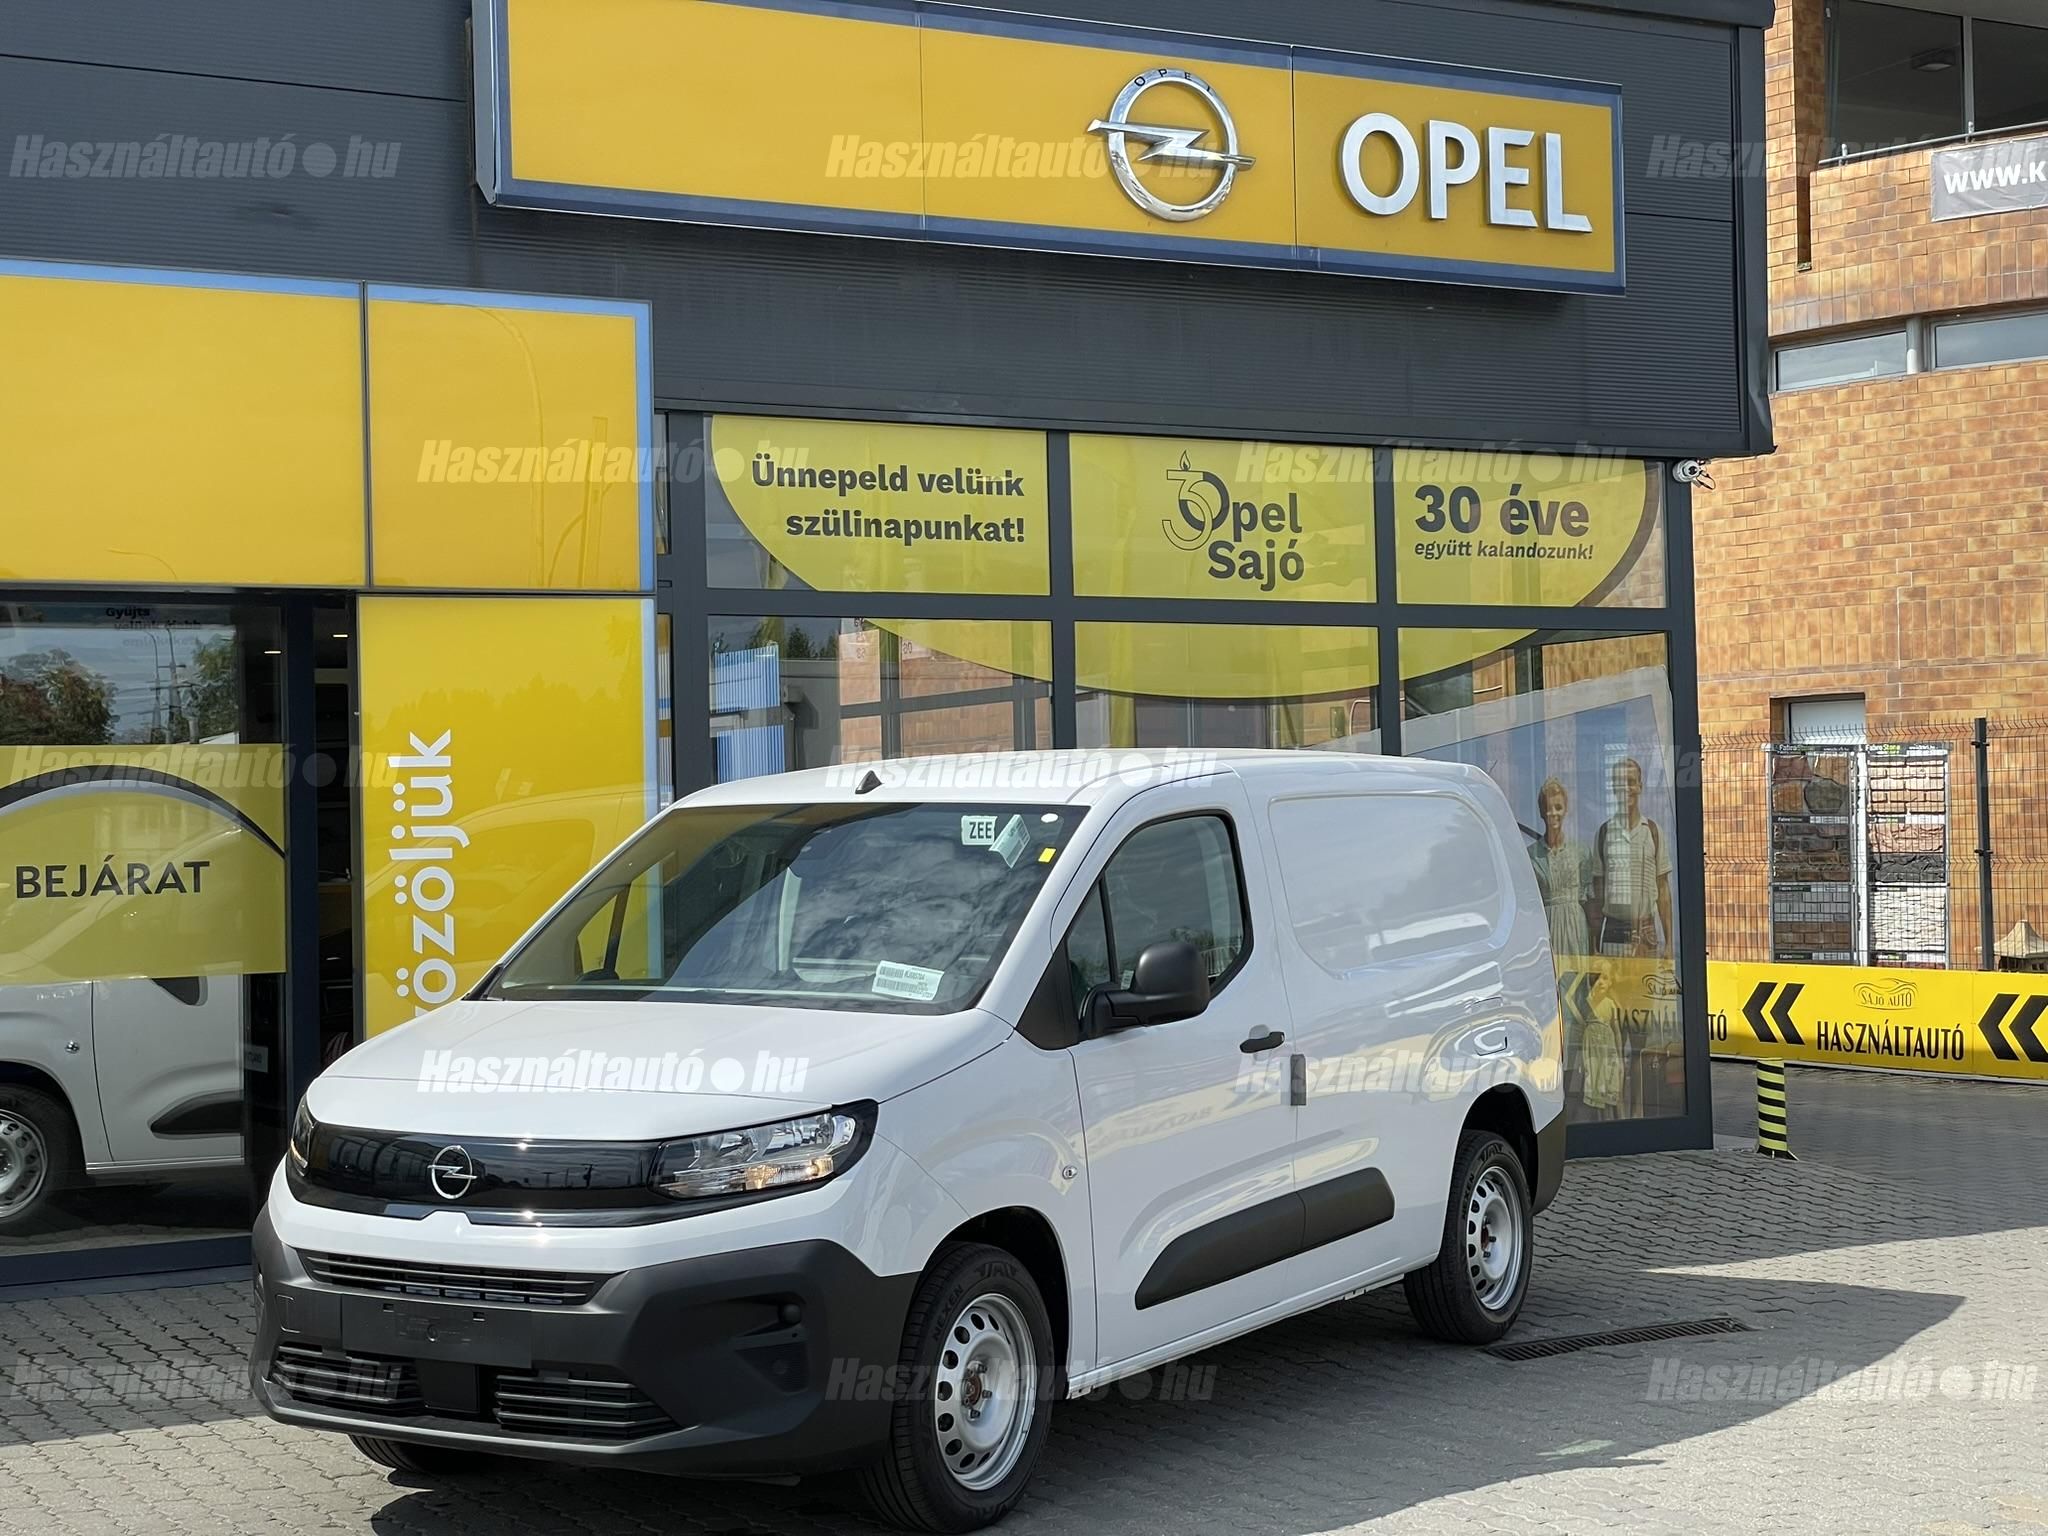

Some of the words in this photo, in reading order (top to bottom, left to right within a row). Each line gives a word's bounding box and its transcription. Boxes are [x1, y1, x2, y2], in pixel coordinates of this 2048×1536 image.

[1339, 112, 1593, 233] OPEL
[752, 452, 908, 497] Ünnepeld
[917, 467, 1025, 497] velünk
[785, 508, 1026, 547] szülinapunkat!
[1415, 484, 1482, 534] 30
[1499, 483, 1590, 538] éve
[1207, 538, 1305, 592] Sajó
[1414, 540, 1472, 561] együtt
[1476, 540, 1594, 561] kalandozunk!
[968, 821, 993, 840] ZEE
[15, 854, 211, 900] BEJÁRAT
[1816, 1018, 1965, 1061] HASZNÁLTAUTÓ
